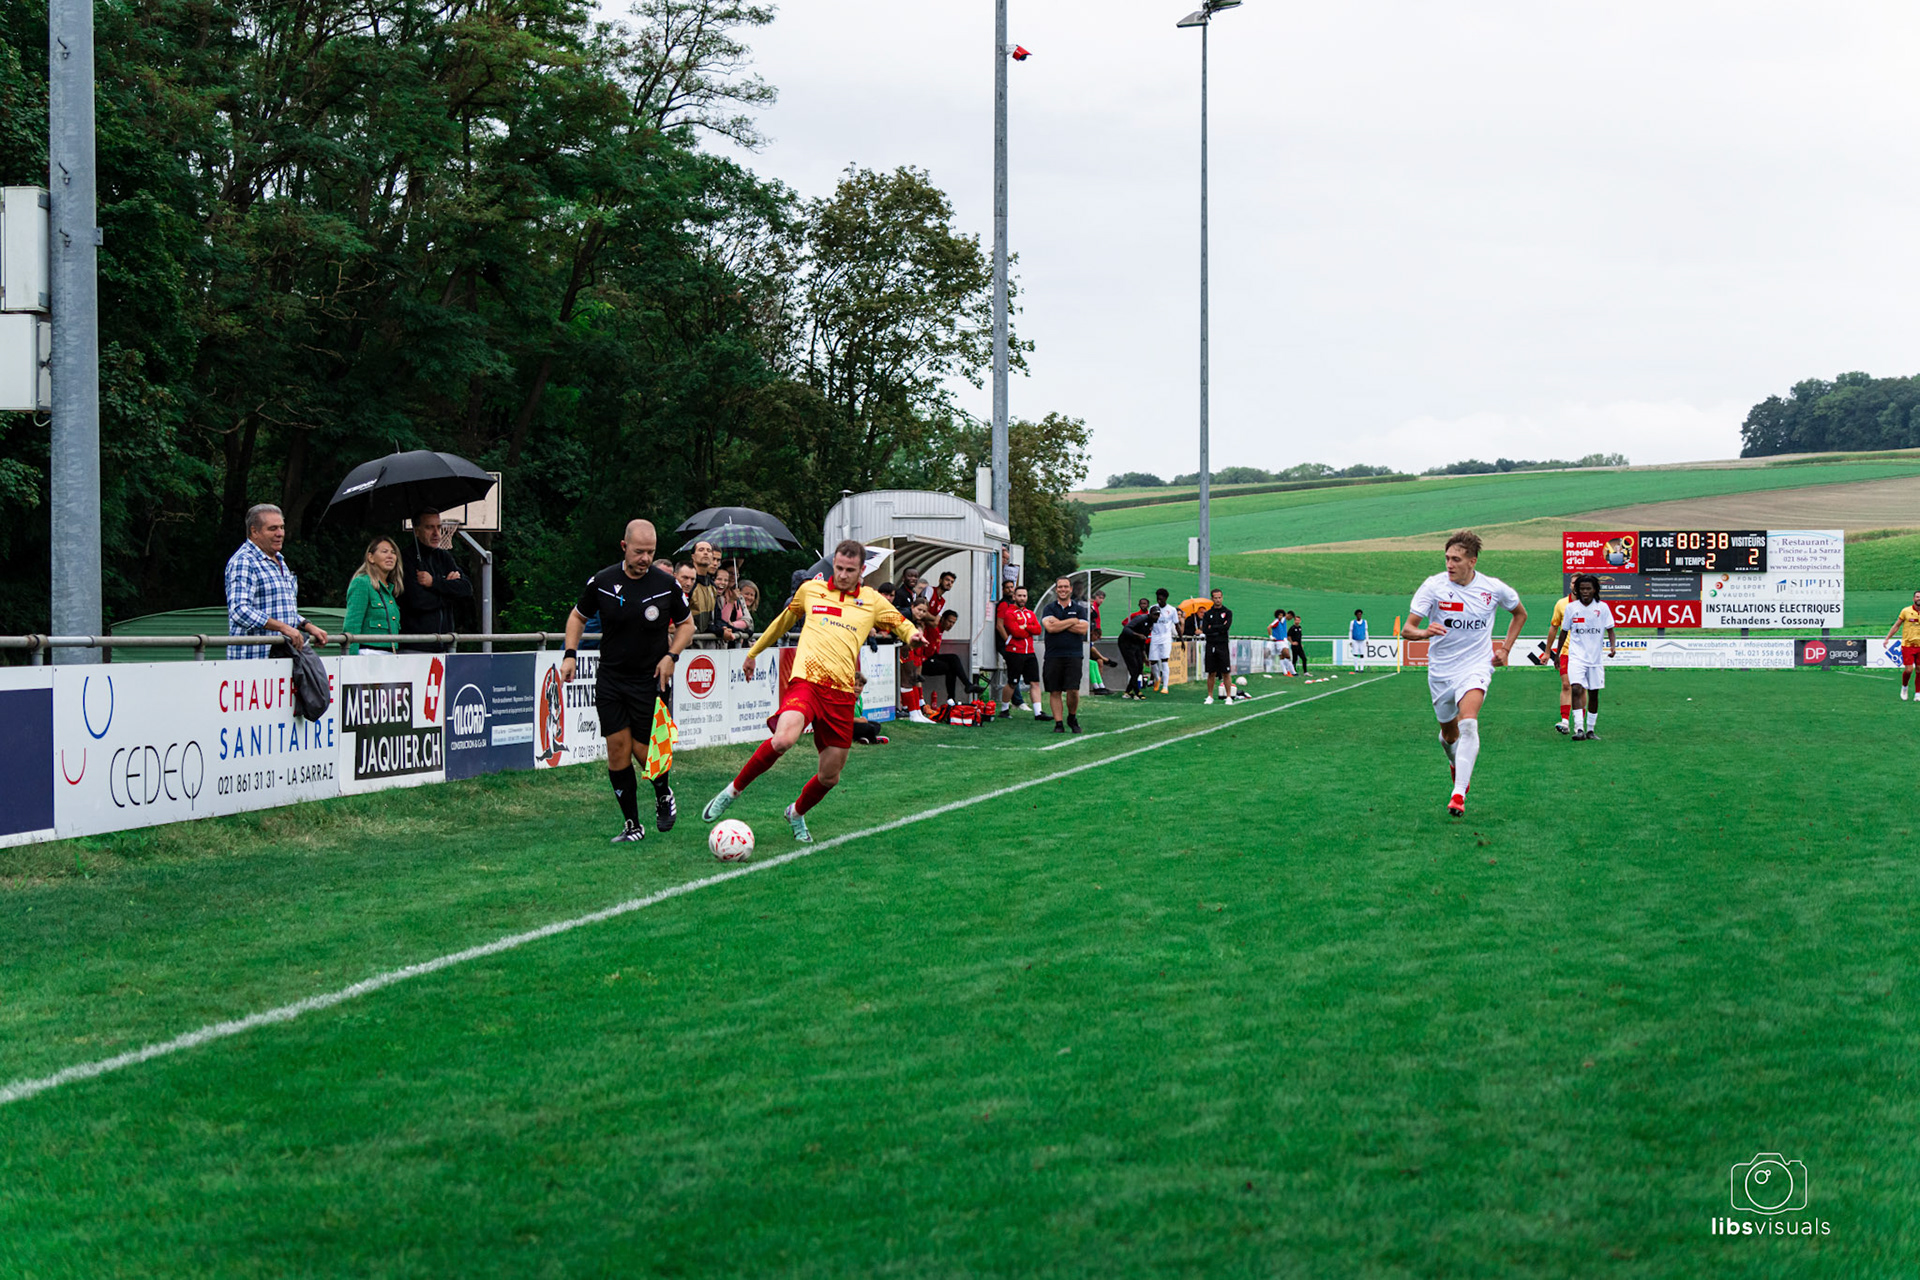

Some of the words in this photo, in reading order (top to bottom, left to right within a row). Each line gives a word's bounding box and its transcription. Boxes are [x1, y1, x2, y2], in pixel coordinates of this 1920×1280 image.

[1576, 540, 1604, 548] multi-
[1641, 537, 1654, 548] FC
[1656, 537, 1674, 548] LSE
[1677, 532, 1729, 550] 80:38
[1731, 536, 1766, 547] VISITEURS
[1566, 556, 1584, 564] d'ici
[1666, 549, 1670, 564] 1
[1675, 557, 1684, 566] MI
[1685, 557, 1706, 566] TEMPS
[1706, 552, 1716, 570] 2
[1748, 548, 1759, 564] 2
[1615, 605, 1662, 624] SAM
[1668, 605, 1696, 624] SA
[1706, 604, 1776, 613] INSTALLATIONS
[1780, 602, 1840, 614] ÉLECTRIQUES
[1452, 619, 1487, 630] OIKEN
[1721, 616, 1770, 625] Echandens
[1781, 616, 1825, 627] Cossonay
[1367, 645, 1398, 658] BCV
[1805, 648, 1826, 660] DP
[1829, 650, 1858, 659] garage
[688, 668, 713, 682] DENNER
[219, 674, 334, 713] CHAUFFE
[345, 687, 410, 727] MEUBLES
[219, 718, 334, 760] SANITAIRE
[358, 732, 441, 775] JAQUIER.CH
[110, 740, 204, 811] CEDEQ
[218, 775, 233, 795] 021
[237, 773, 252, 792] 861
[254, 771, 264, 790] 31
[266, 770, 276, 788] 31
[287, 767, 298, 786] LA
[300, 762, 334, 784] SARRAZ
